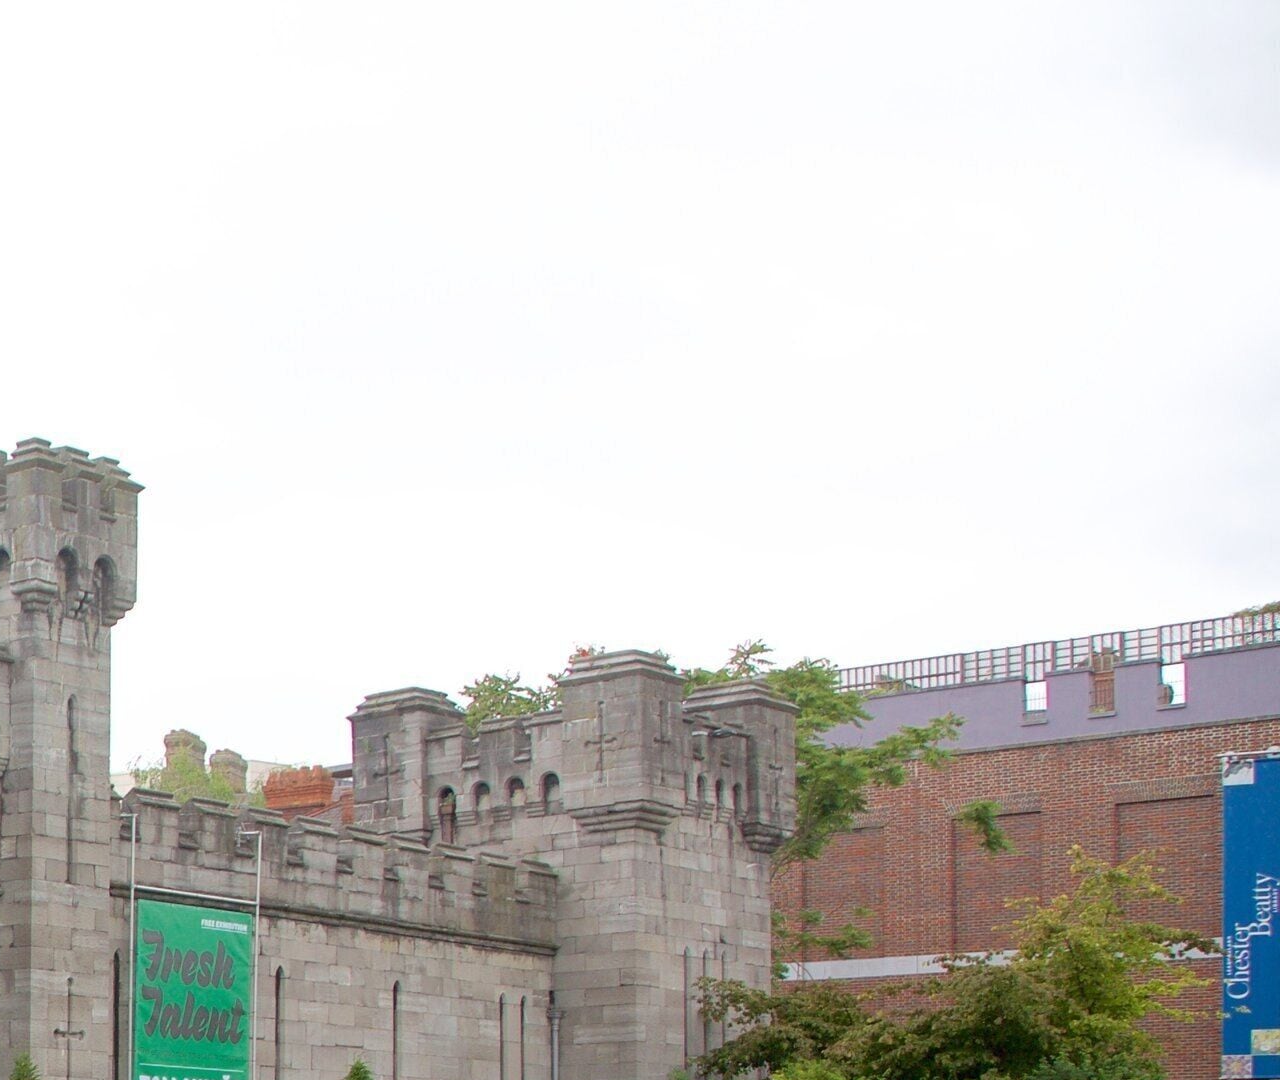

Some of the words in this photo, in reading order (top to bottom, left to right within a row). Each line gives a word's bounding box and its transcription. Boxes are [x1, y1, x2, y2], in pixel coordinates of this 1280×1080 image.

[1249, 872, 1280, 937] Beatty
[142, 929, 235, 989] Fresh
[1225, 922, 1250, 999] Chester
[142, 984, 244, 1044] Talent
